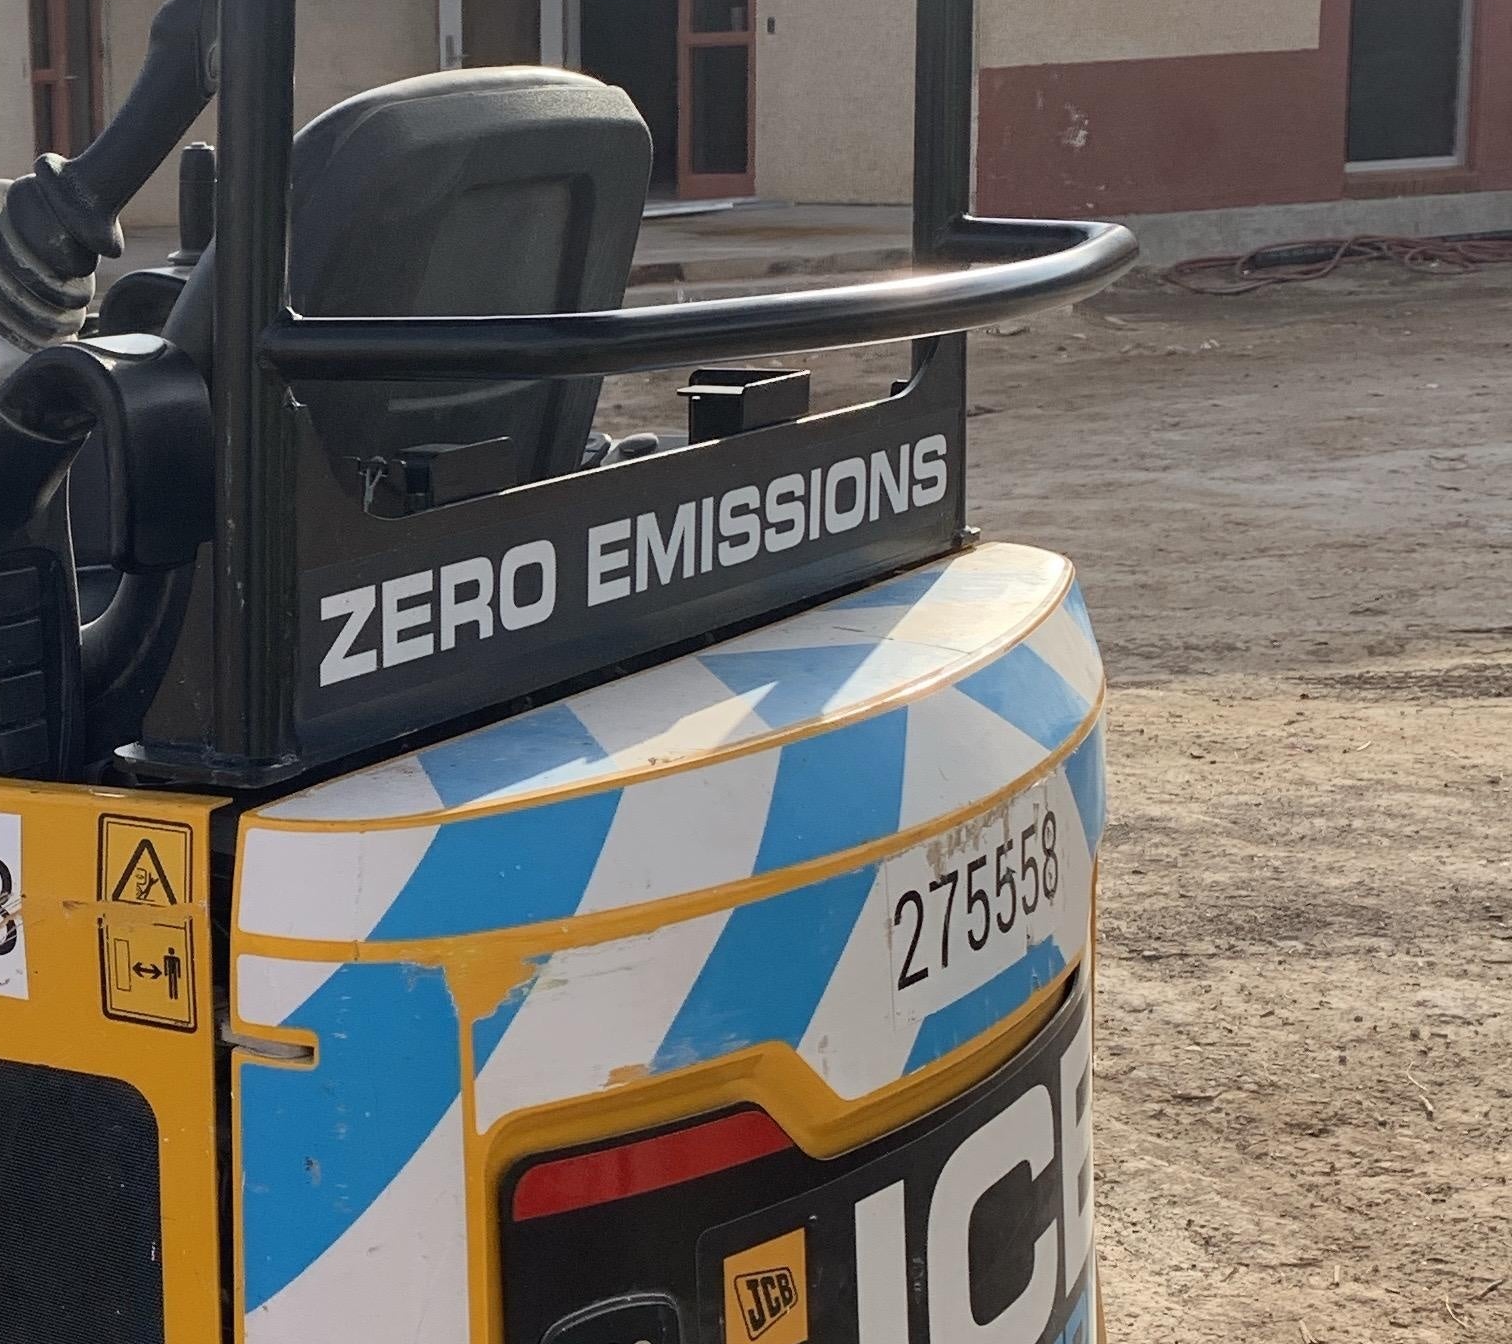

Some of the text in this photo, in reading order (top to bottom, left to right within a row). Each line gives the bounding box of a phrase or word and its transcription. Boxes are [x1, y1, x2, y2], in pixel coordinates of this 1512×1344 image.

[319, 433, 949, 688] ZERO EMISSIONS
[893, 809, 1060, 992] 275558
[745, 1272, 794, 1332] JCB
